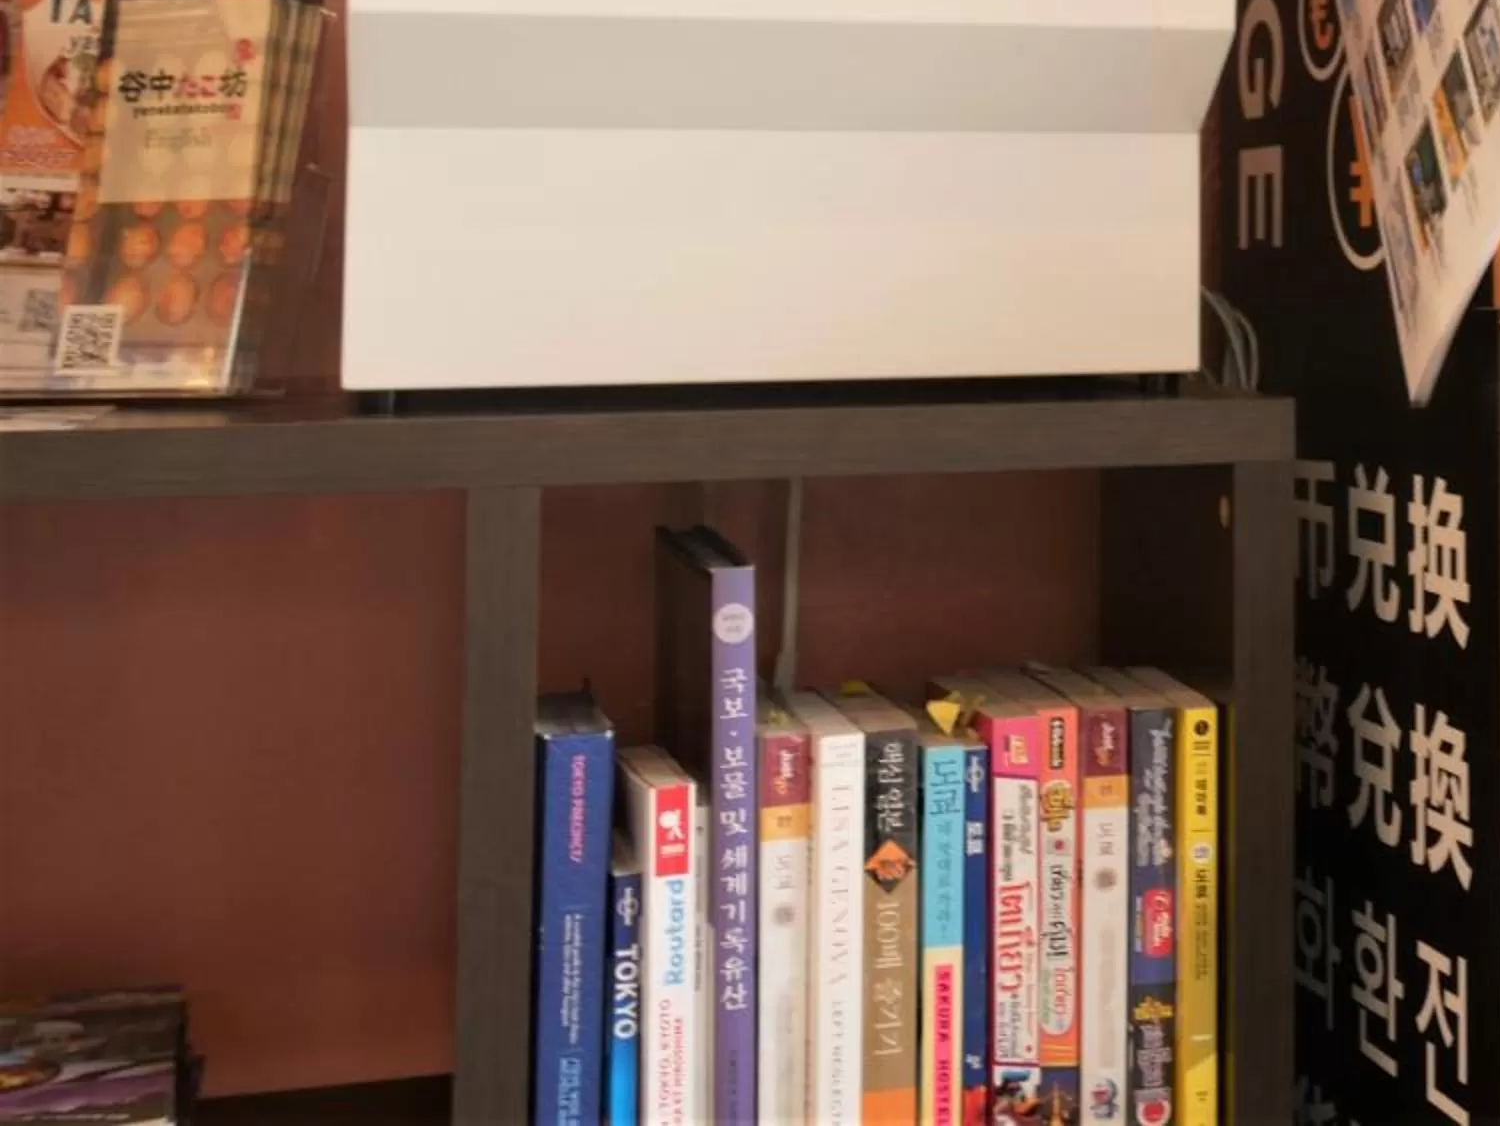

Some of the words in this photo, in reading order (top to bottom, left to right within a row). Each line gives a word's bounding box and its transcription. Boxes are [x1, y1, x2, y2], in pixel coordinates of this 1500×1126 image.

[829, 785, 854, 851] LISA
[662, 879, 686, 987] Routard
[829, 863, 854, 988] GENOVA
[613, 944, 640, 1041] TOKYO
[938, 970, 952, 1043] SAKURA
[938, 1058, 952, 1126] HOSTEL
